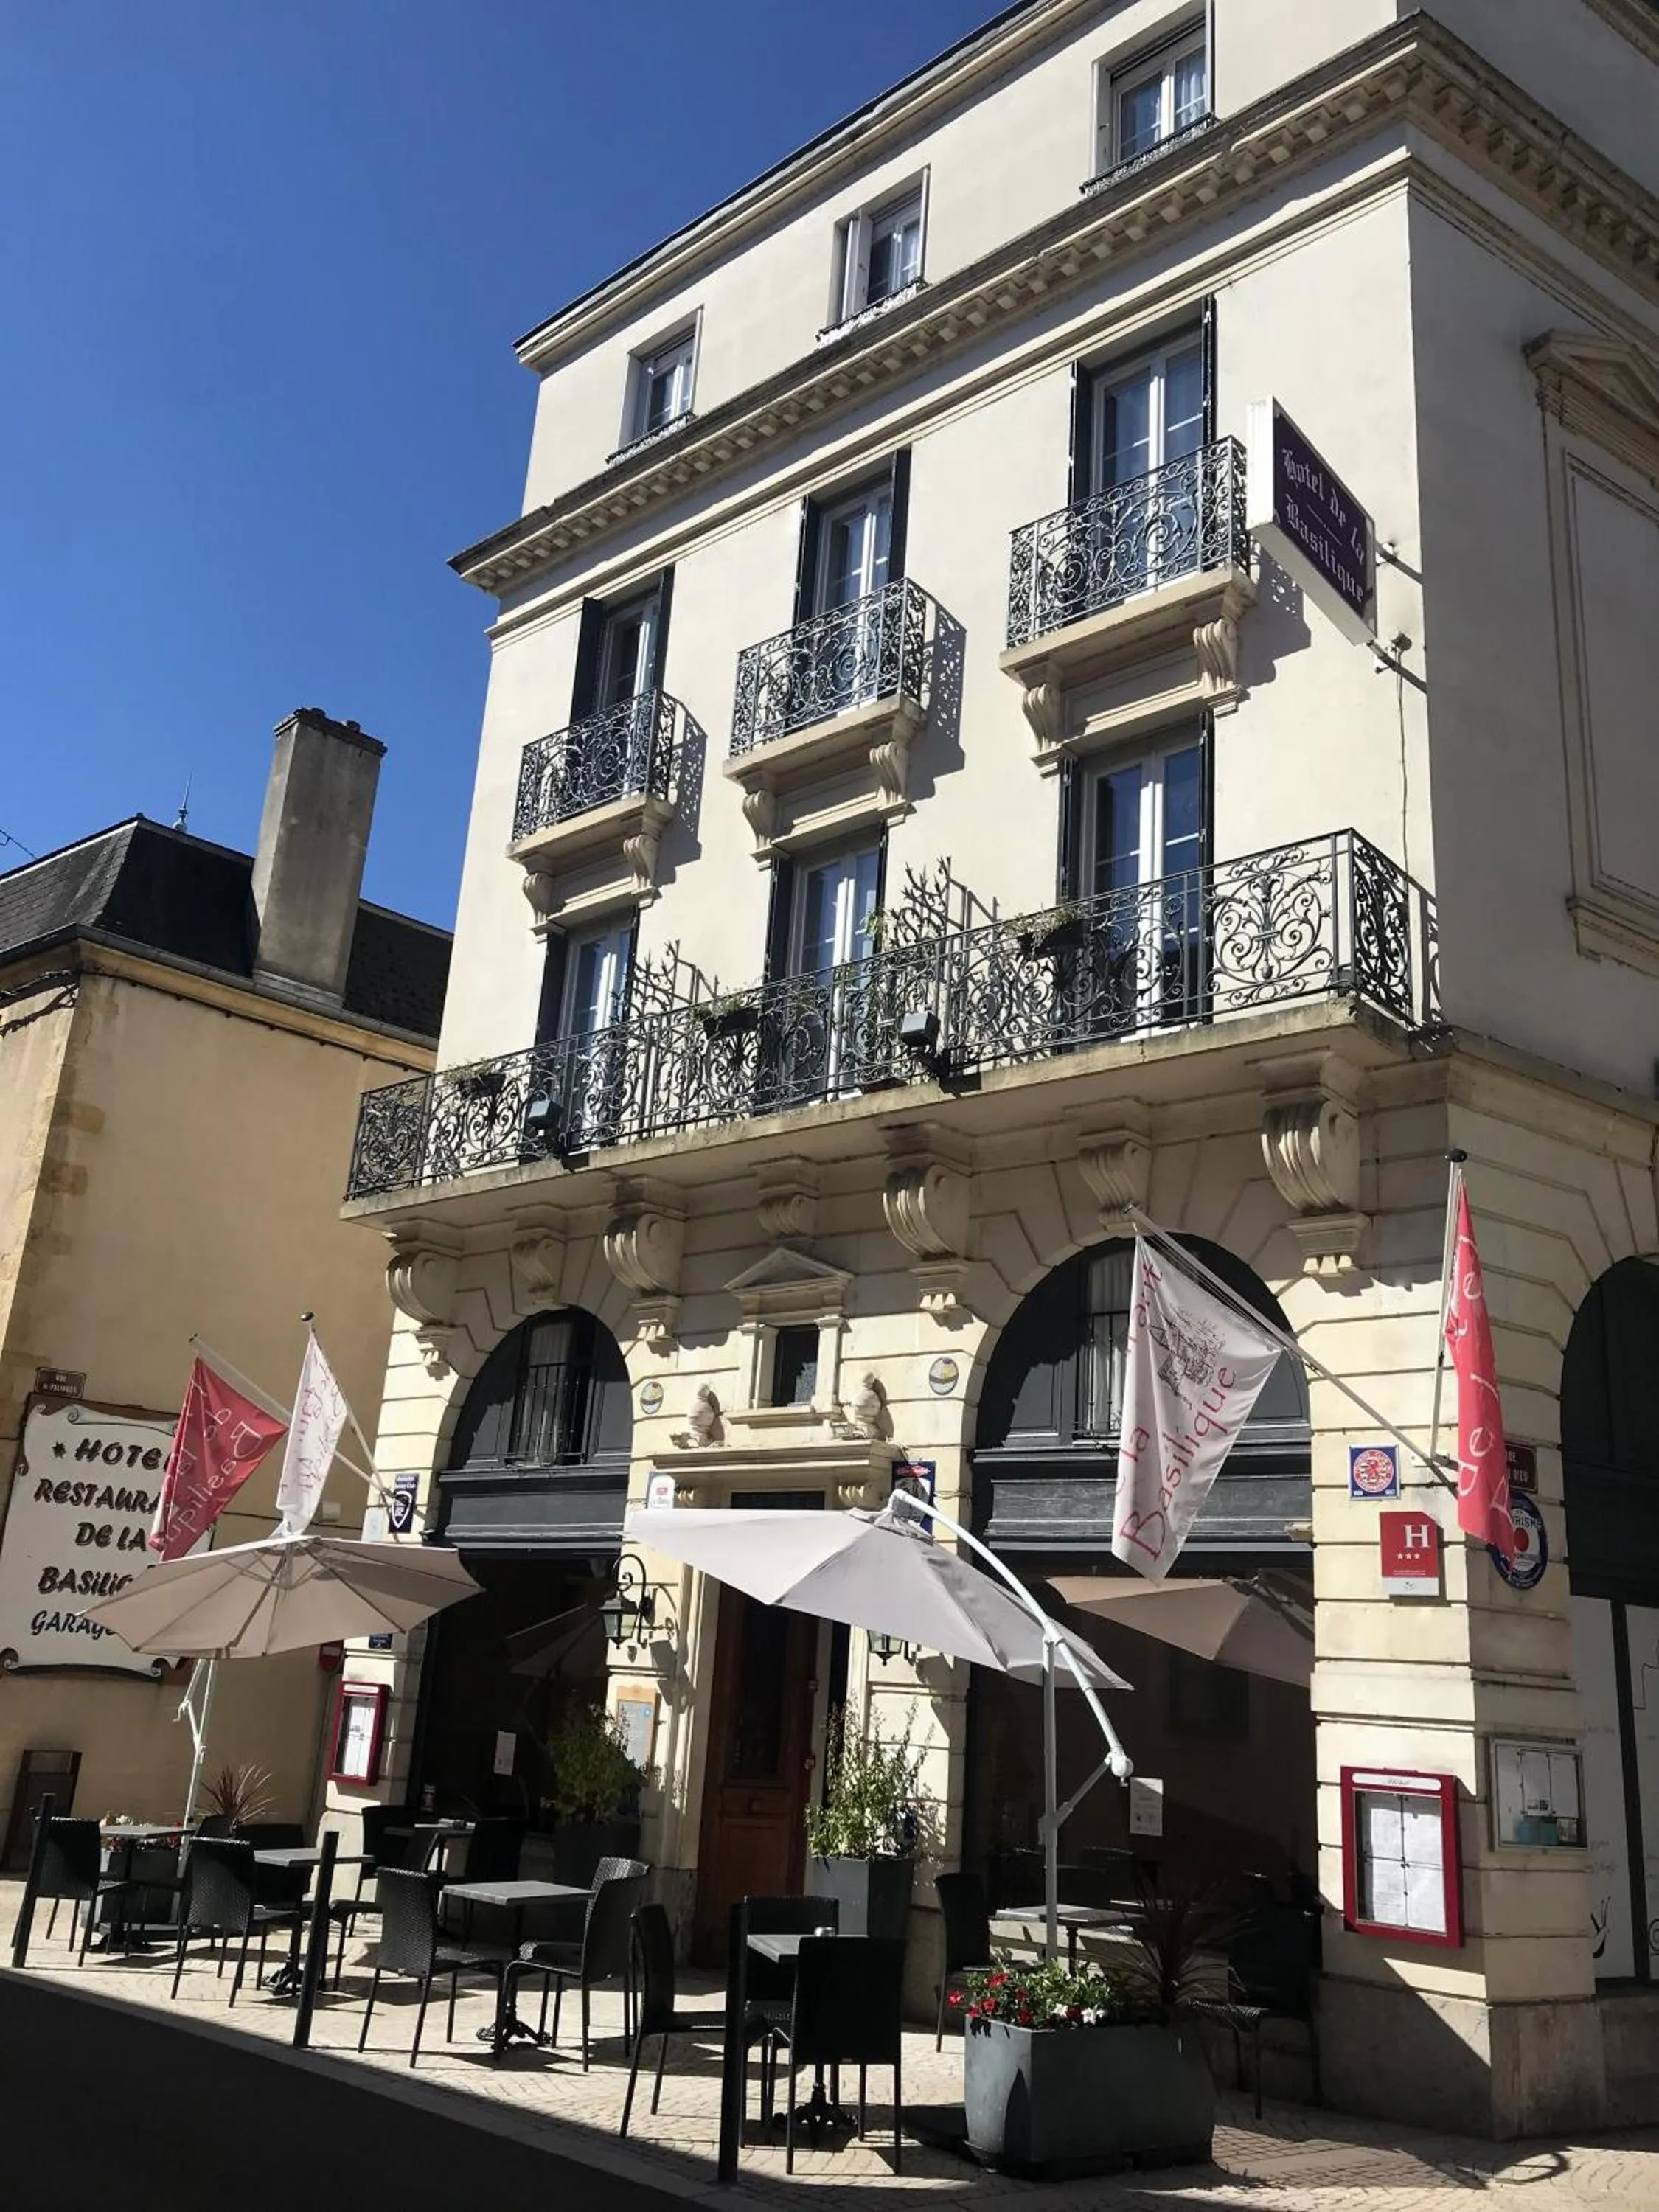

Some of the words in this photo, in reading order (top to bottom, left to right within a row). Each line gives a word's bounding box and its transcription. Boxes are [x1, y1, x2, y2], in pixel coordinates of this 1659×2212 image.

[1285, 493, 1364, 603] Basilique
[74, 1438, 171, 1471] HOTE
[1119, 1366, 1237, 1562] Basilique
[34, 1478, 160, 1514] RESTAURA
[75, 1522, 114, 1548] DE
[116, 1526, 147, 1552] LA
[1404, 1524, 1430, 1548] H
[38, 1566, 133, 1596] BASILI
